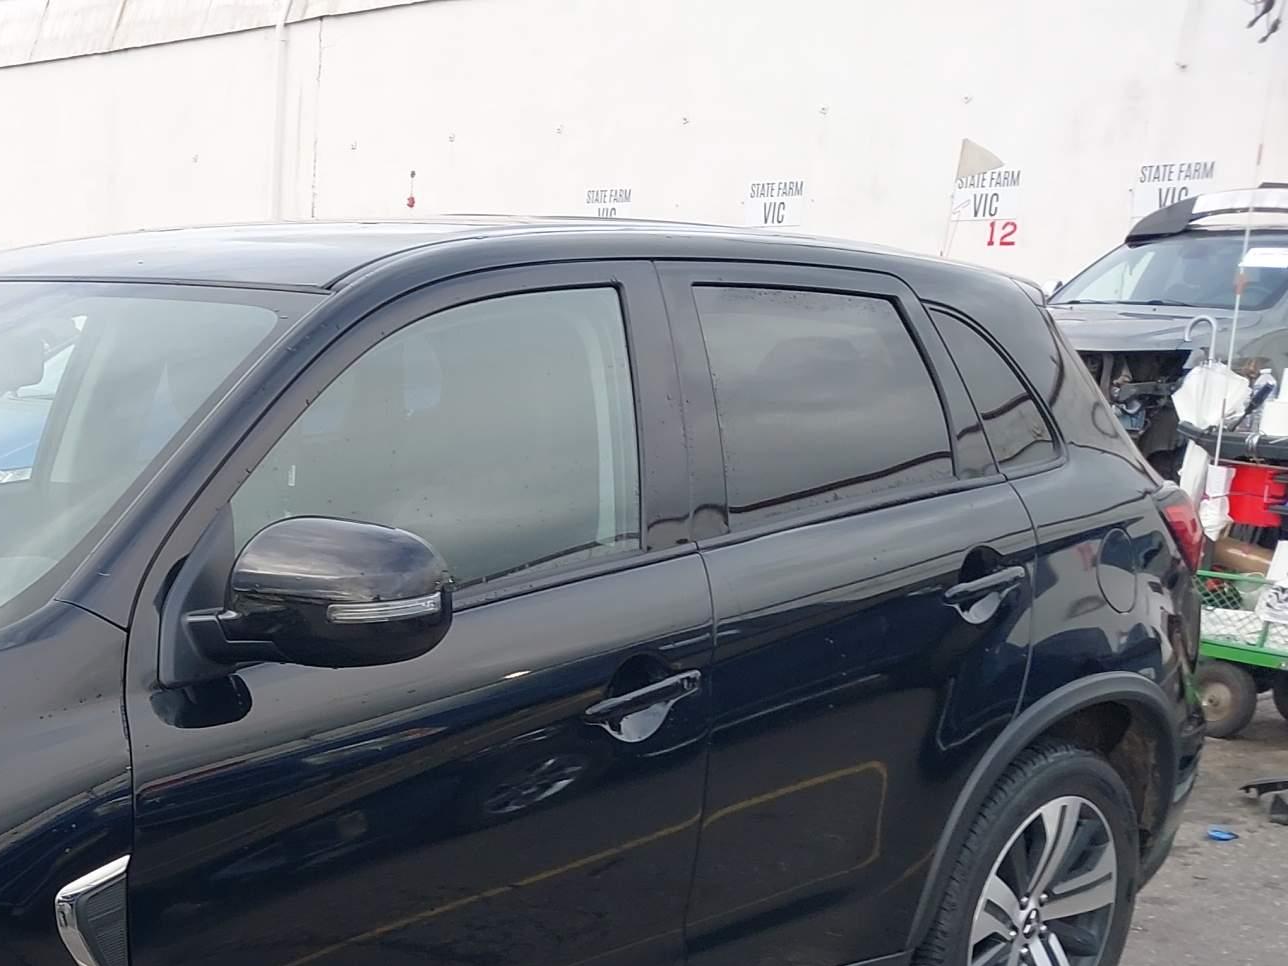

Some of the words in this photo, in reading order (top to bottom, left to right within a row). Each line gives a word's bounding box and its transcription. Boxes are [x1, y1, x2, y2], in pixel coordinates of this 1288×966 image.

[989, 170, 1021, 187] FARM
[1140, 164, 1176, 183] STATE
[1178, 161, 1215, 181] FARM
[586, 190, 608, 204] STATE
[609, 188, 632, 203] FARM
[750, 184, 775, 199] STATE
[777, 180, 804, 197] FARM
[763, 201, 786, 224] VIC
[973, 192, 999, 218] VIC
[987, 221, 1017, 246] 12
